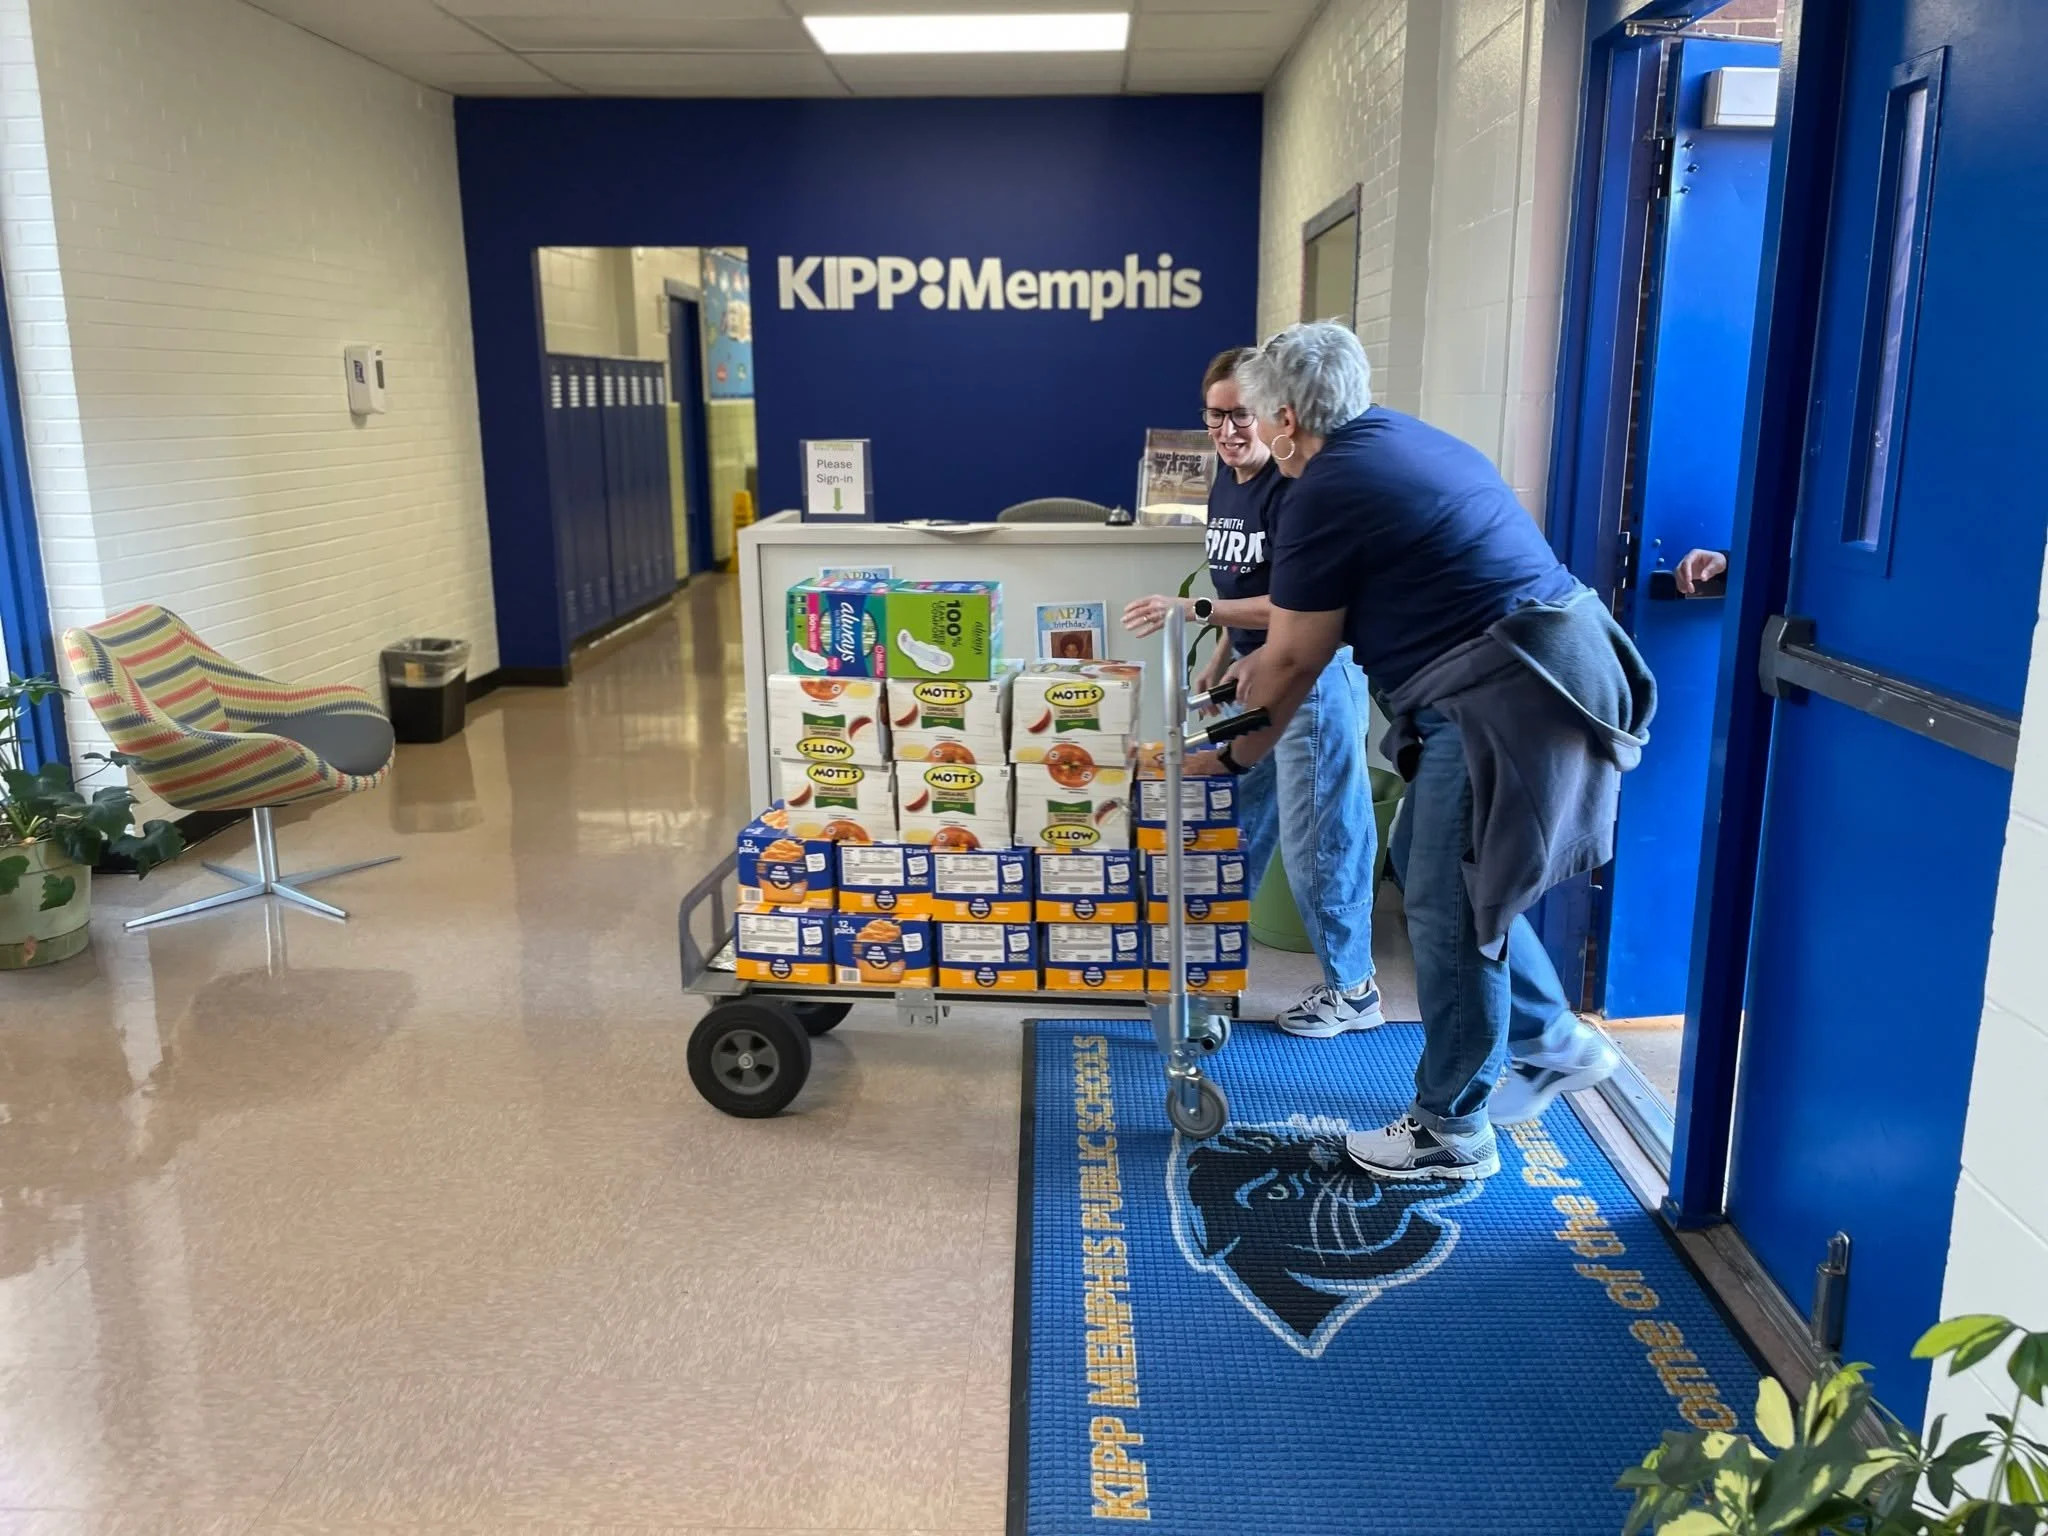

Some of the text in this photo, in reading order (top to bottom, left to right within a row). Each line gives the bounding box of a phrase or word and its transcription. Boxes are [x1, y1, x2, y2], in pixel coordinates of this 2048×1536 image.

[1155, 452, 1202, 461] welcome
[816, 459, 853, 469] Please
[816, 473, 854, 485] Sign-in
[946, 600, 962, 647] 100%
[1054, 620, 1087, 629] birthday
[834, 602, 861, 663] always
[971, 621, 986, 656] always
[743, 839, 754, 847] 12
[739, 846, 760, 854] pack
[838, 920, 849, 928] 12
[834, 926, 857, 936] pack
[1551, 1194, 1627, 1259] the
[1072, 1034, 1151, 1521] KIPP MEMPHIS PUBLIC SCHOOLS
[1573, 1262, 1660, 1311] of
[1628, 1319, 1738, 1431] ome
